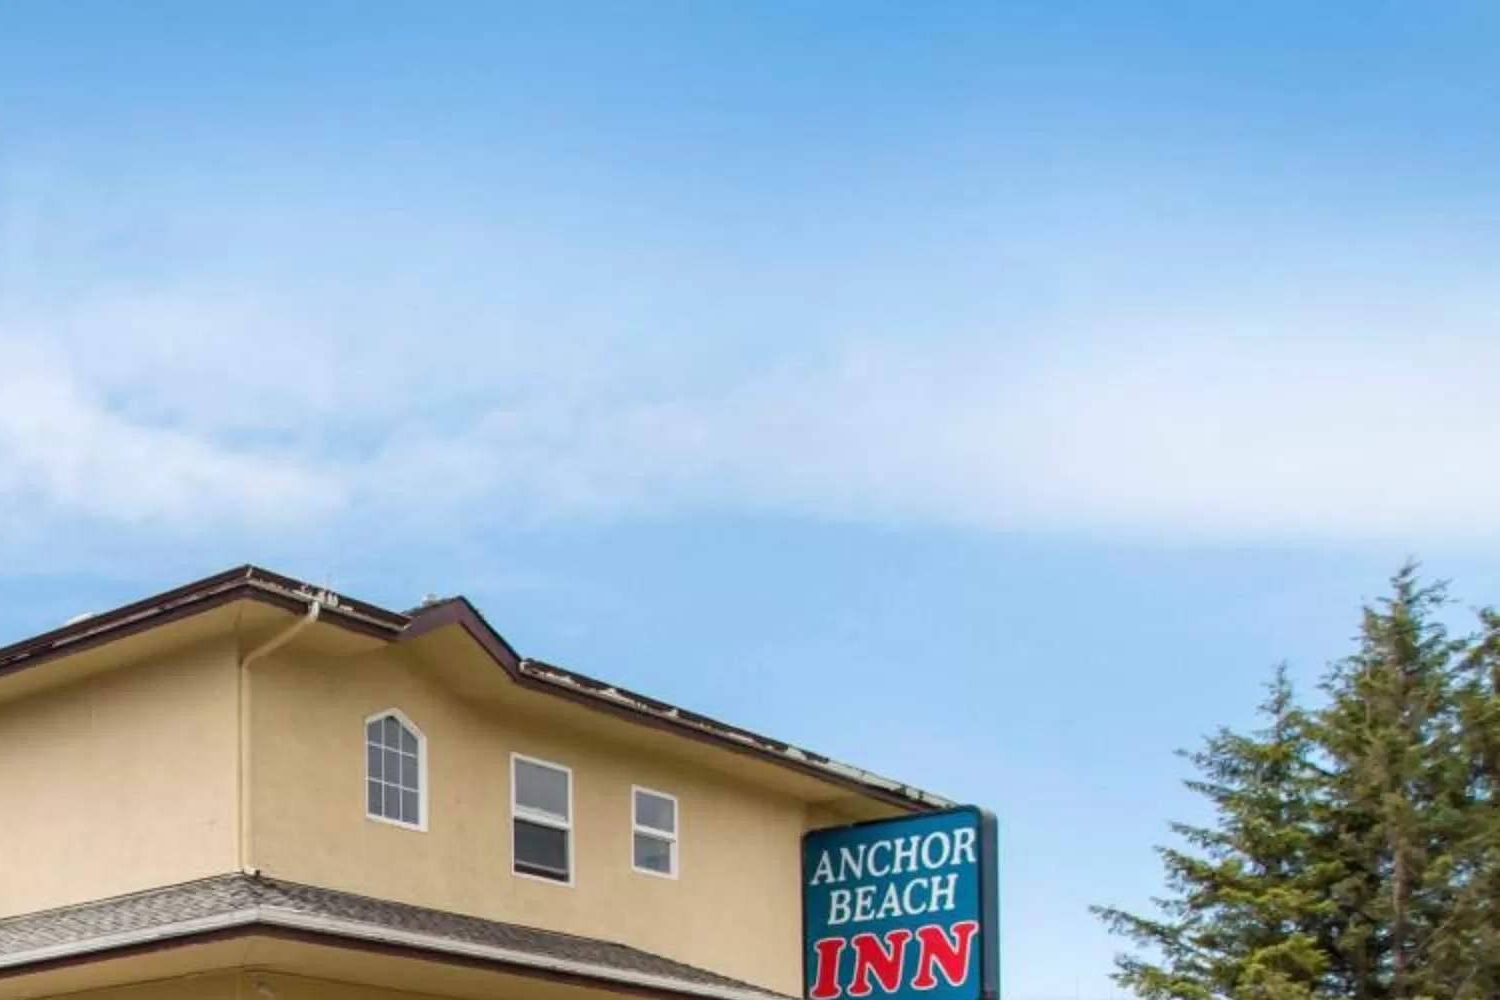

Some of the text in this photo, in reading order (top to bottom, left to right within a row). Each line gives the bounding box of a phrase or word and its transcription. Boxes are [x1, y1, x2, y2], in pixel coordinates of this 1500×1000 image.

[810, 827, 977, 886] ANCHOR
[827, 873, 959, 925] BEACH
[809, 919, 980, 1000] INN
